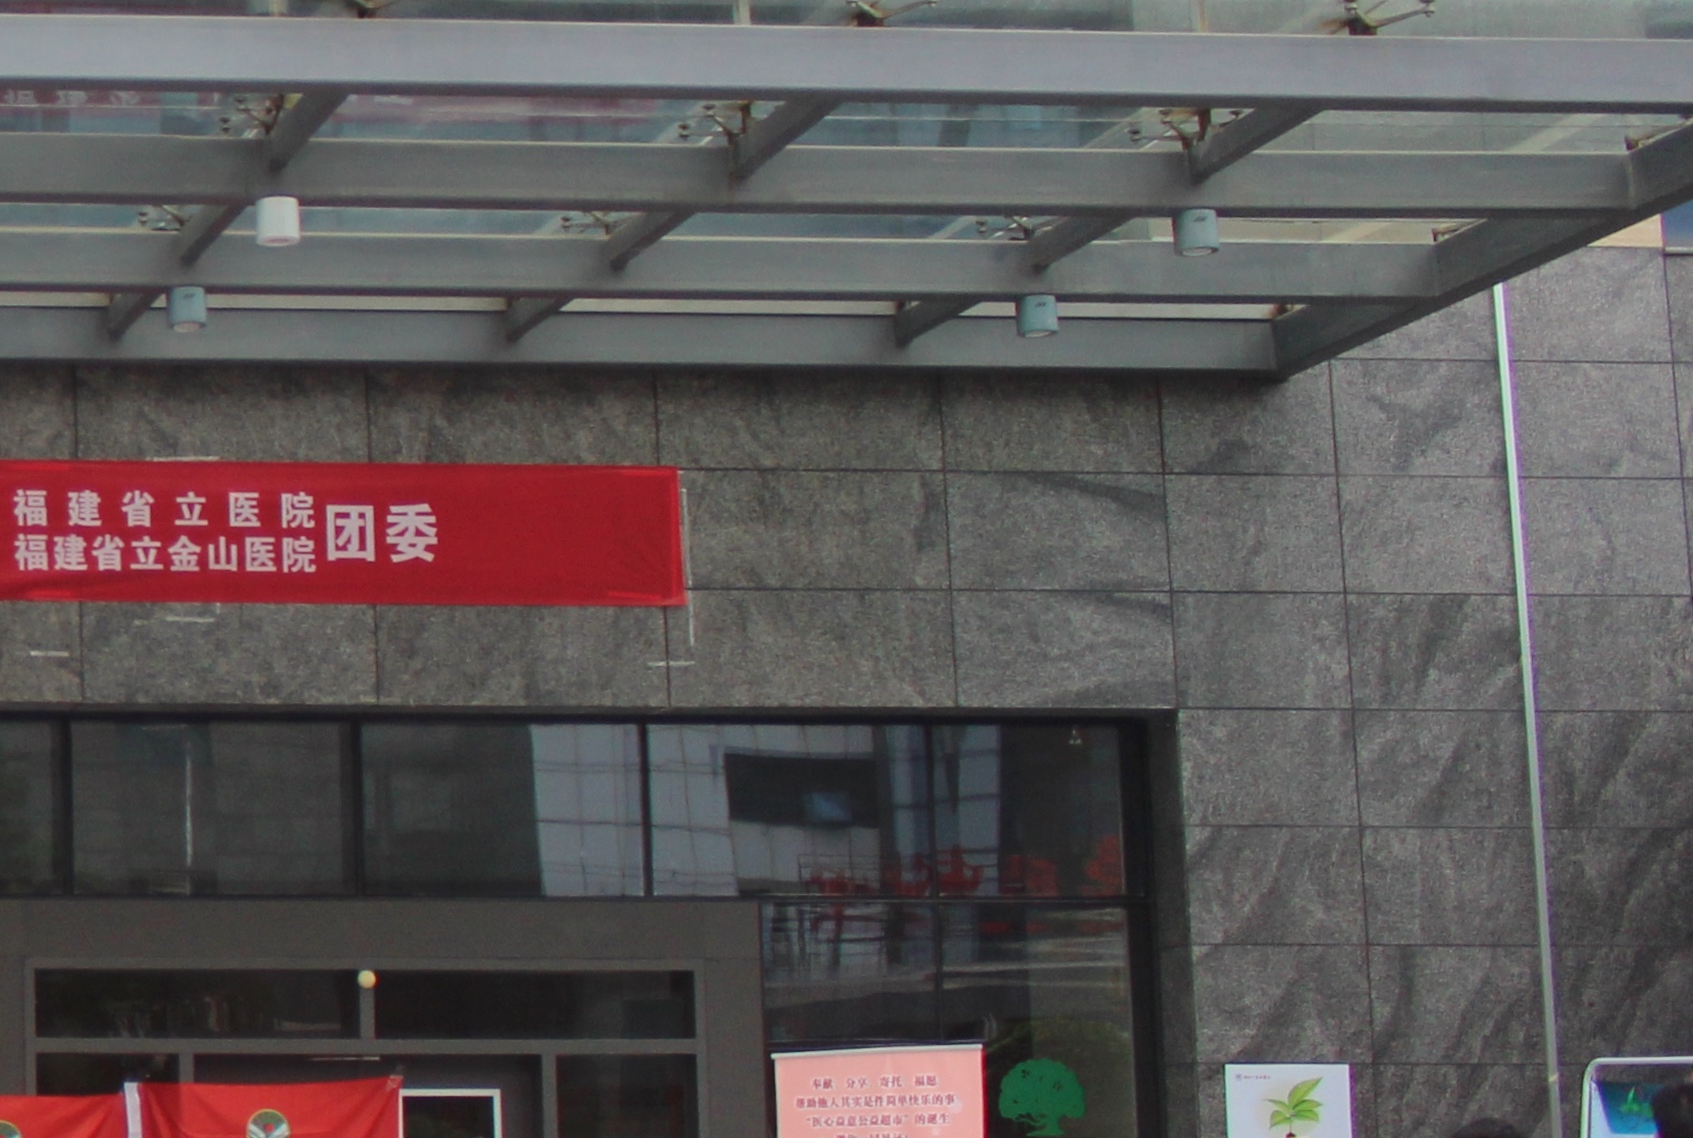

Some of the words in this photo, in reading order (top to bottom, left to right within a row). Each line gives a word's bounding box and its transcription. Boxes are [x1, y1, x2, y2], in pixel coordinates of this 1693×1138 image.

[14, 489, 317, 530] 福建省立医院
[326, 502, 440, 563] 团委
[15, 533, 318, 574] 福建省立金山医院
